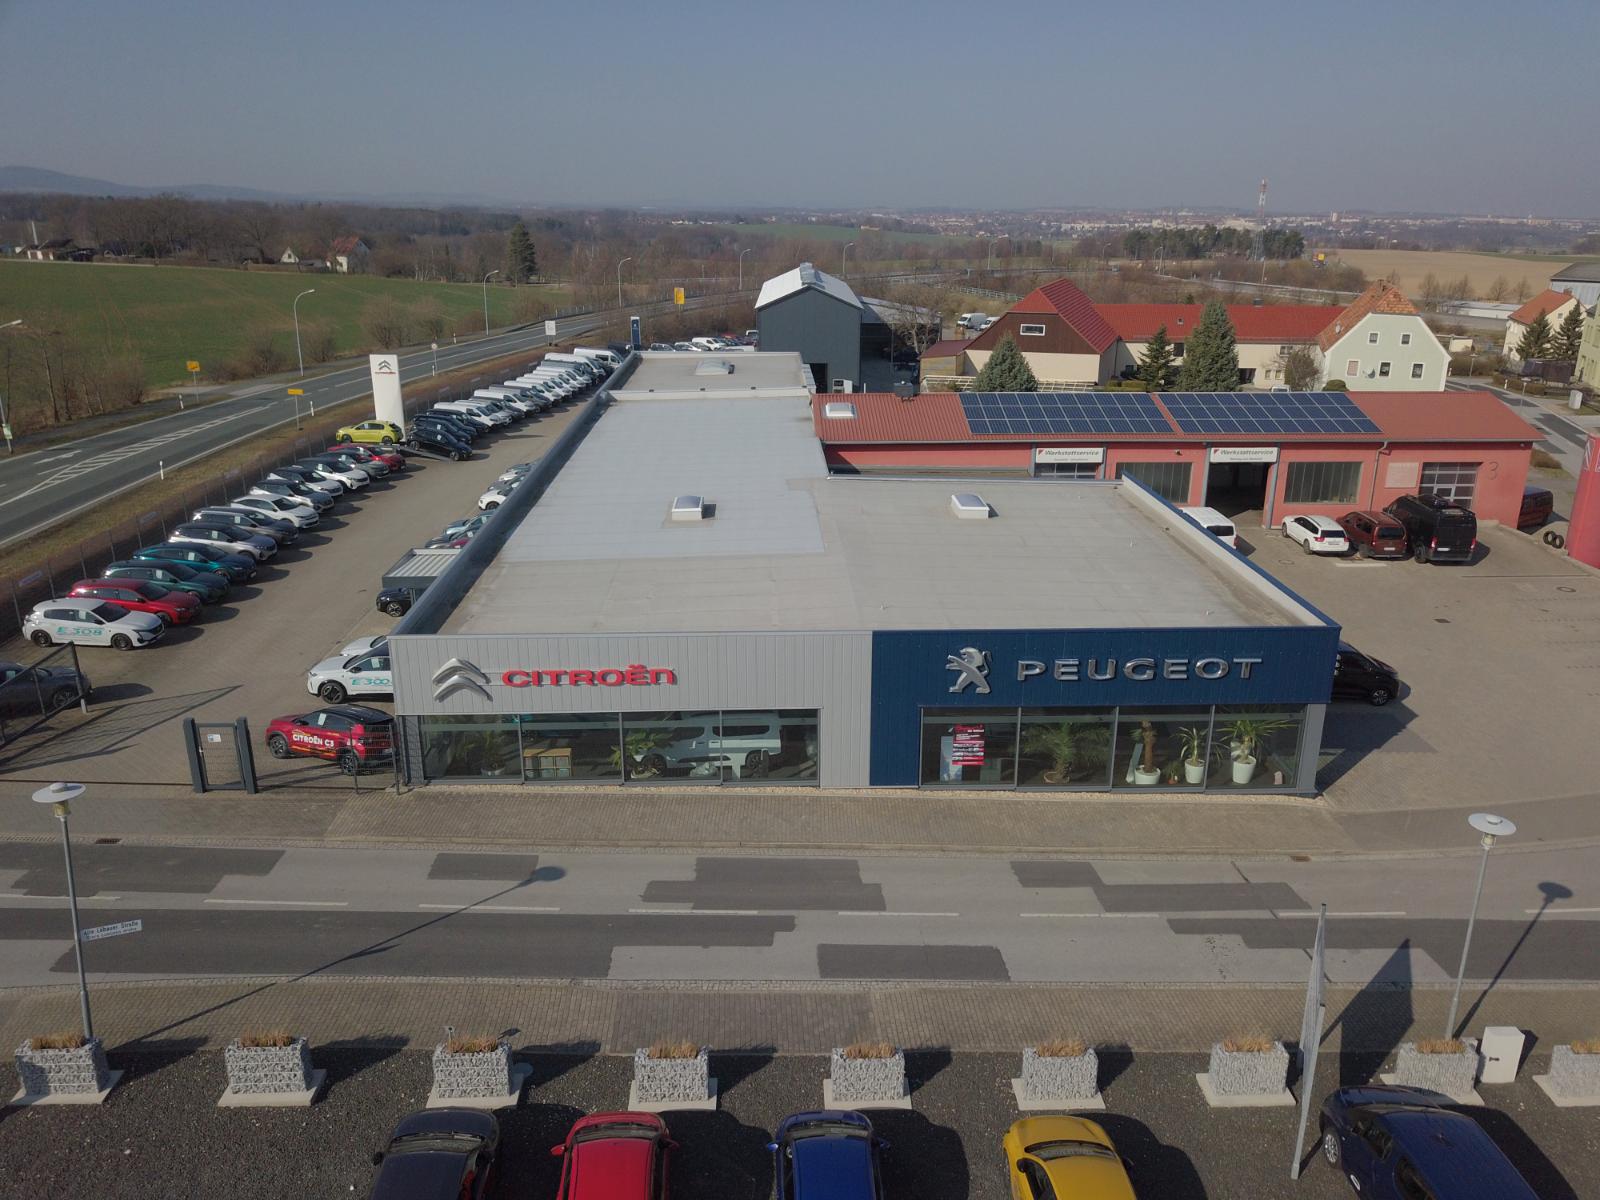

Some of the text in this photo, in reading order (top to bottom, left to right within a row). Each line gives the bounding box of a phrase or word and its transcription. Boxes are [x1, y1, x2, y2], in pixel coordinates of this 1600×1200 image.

[1016, 657, 1263, 682] PEUGEOT
[292, 733, 323, 746] CITROËN
[324, 738, 335, 747] C3
